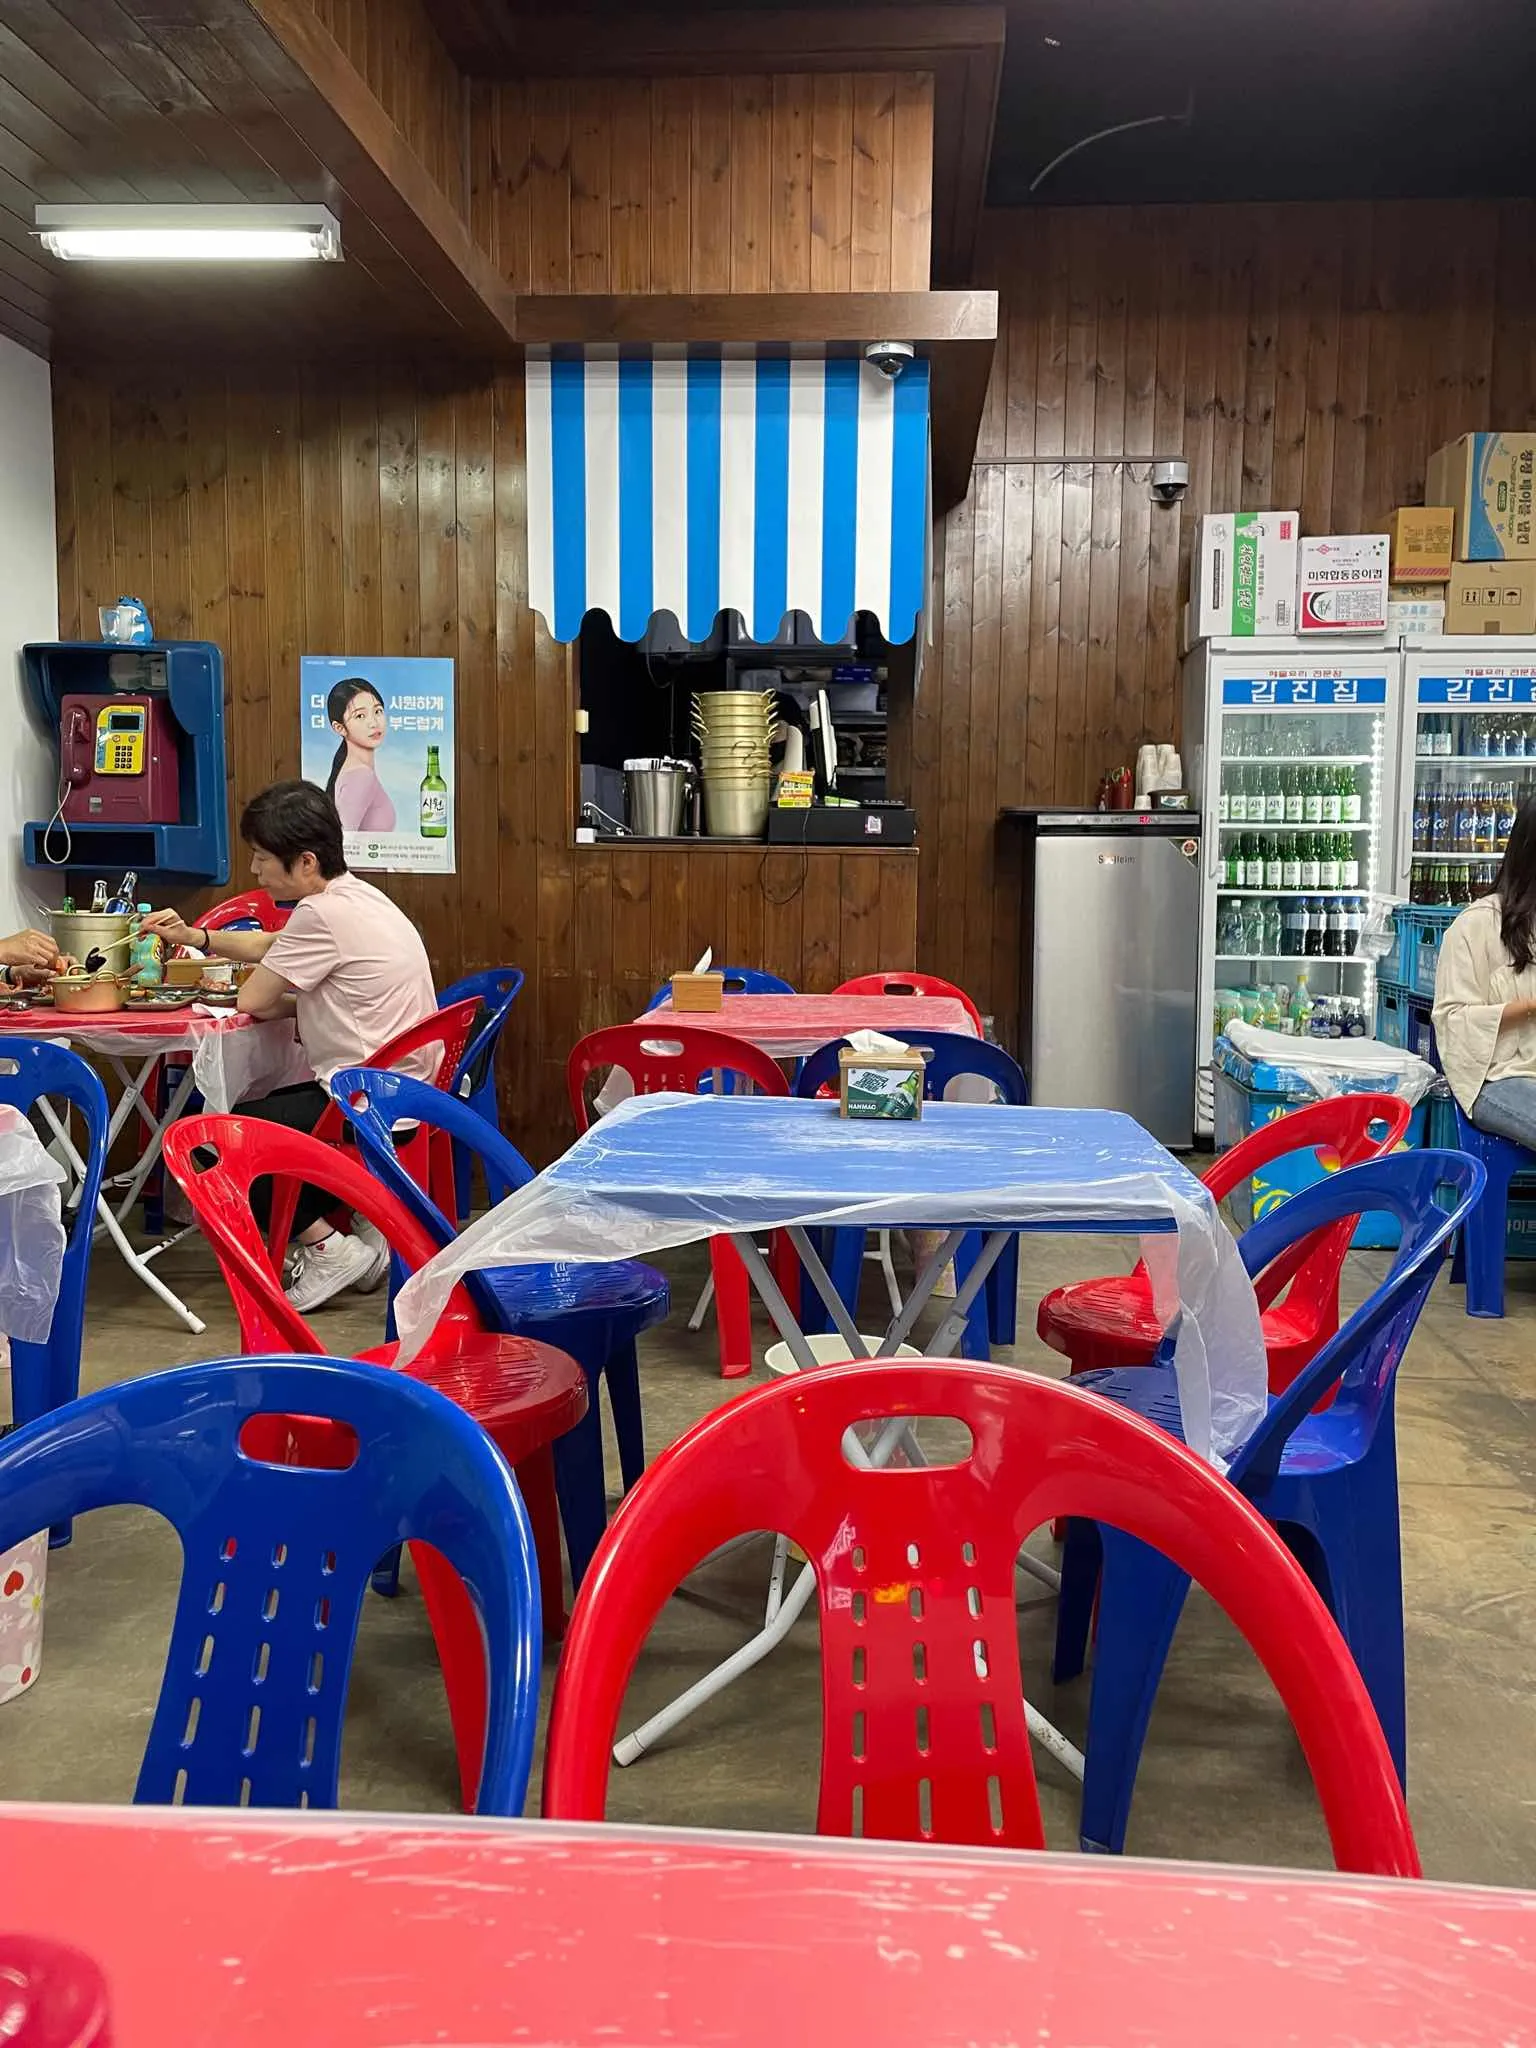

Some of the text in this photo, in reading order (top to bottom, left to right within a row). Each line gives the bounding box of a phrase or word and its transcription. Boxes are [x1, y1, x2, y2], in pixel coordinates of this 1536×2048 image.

[1446, 679, 1536, 703] 갑진
[310, 694, 445, 712] 더 시원하게
[310, 714, 445, 733] 더 부드럽게
[422, 797, 445, 812] 시원
